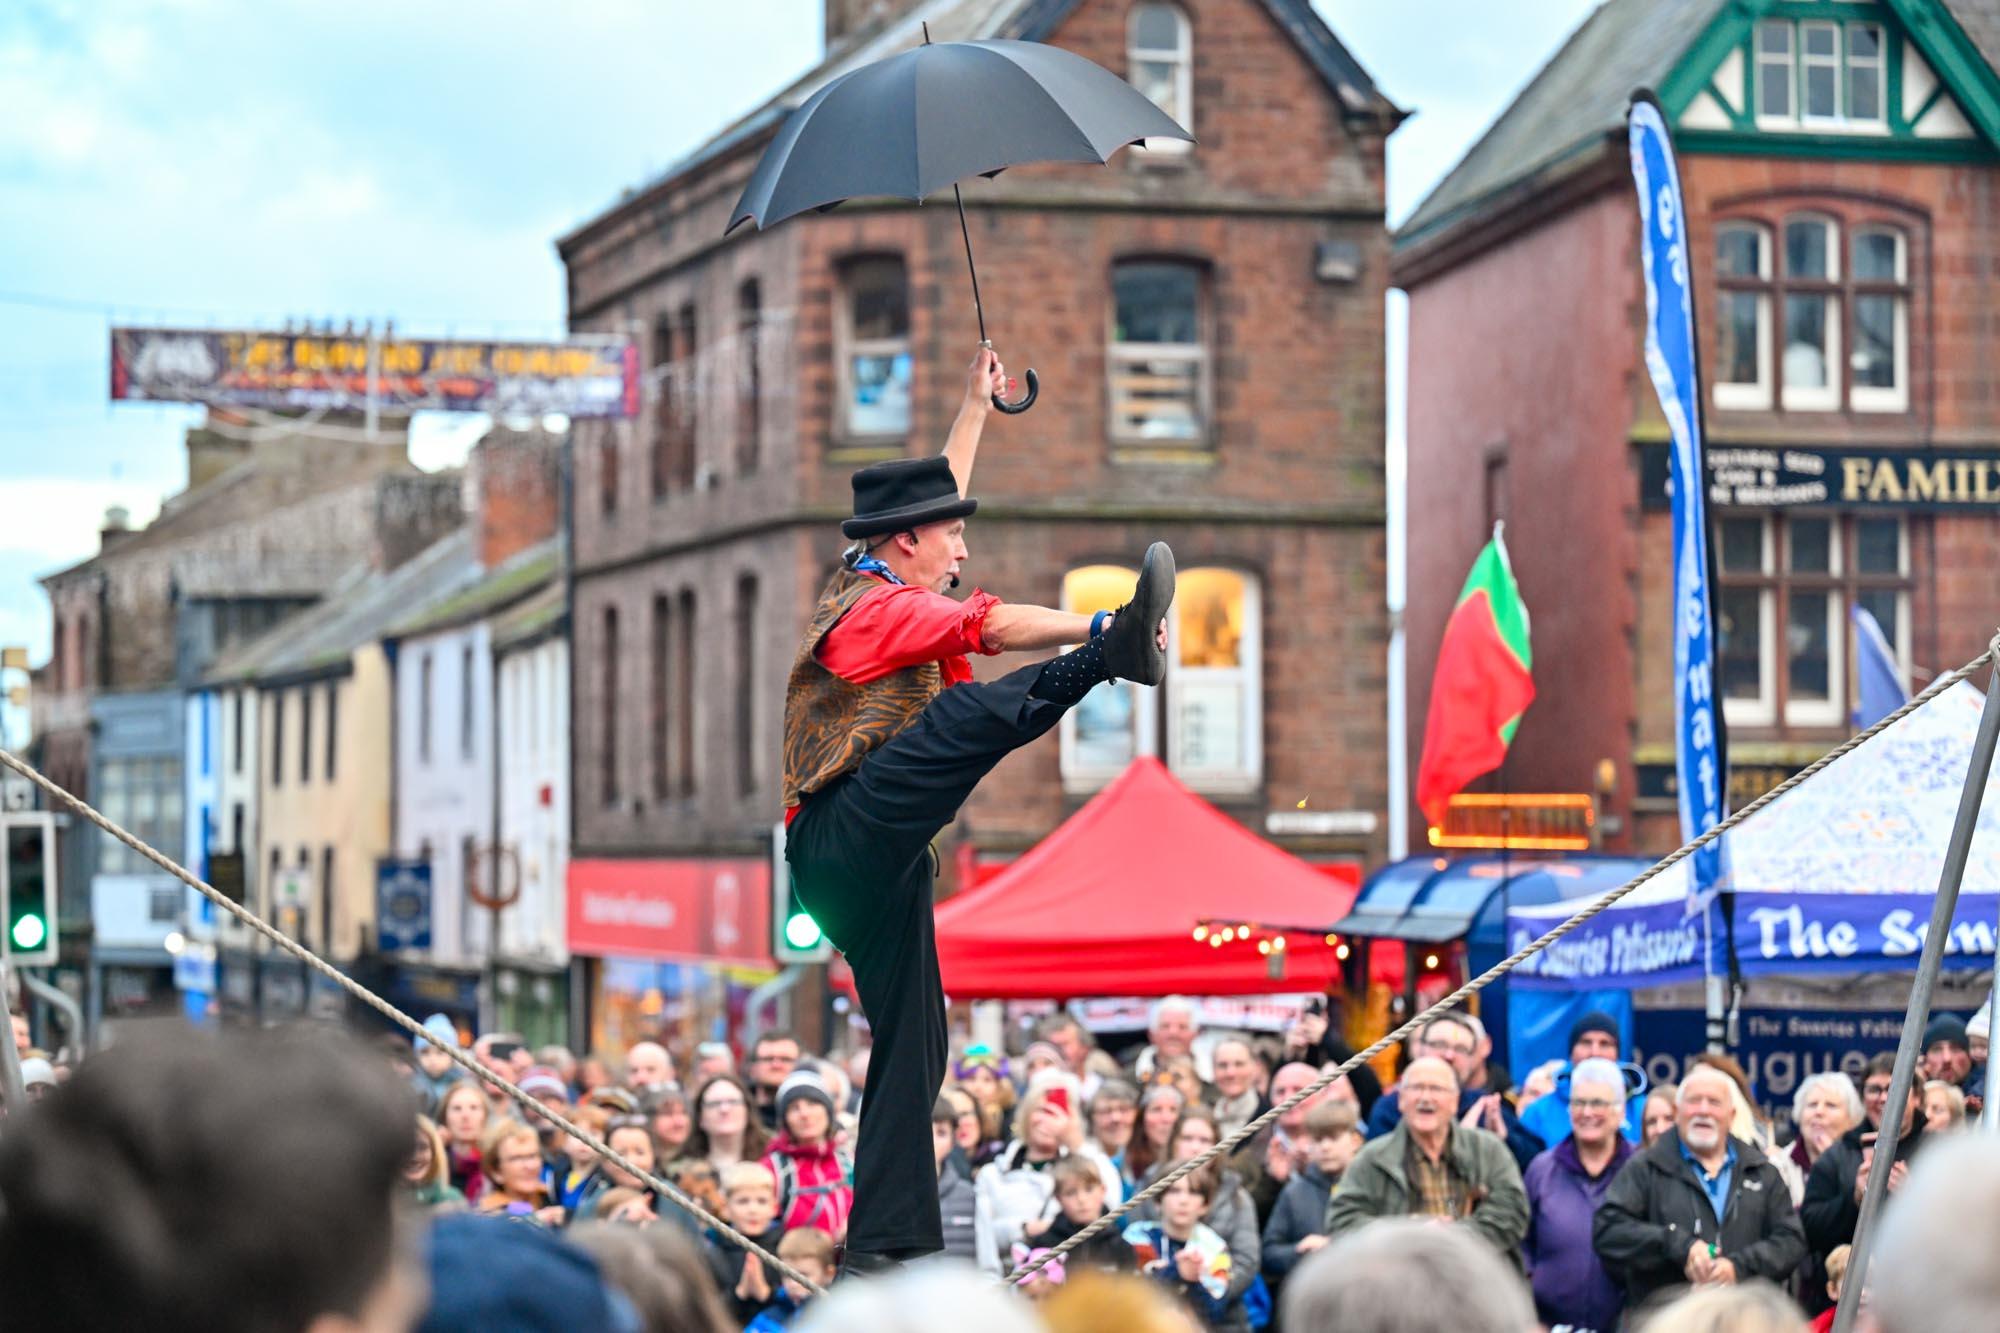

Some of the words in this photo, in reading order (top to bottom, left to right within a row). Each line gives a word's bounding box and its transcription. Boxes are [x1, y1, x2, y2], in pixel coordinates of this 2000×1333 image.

[1841, 457, 2000, 503] FAMIL
[1748, 903, 1859, 959] The
[1880, 908, 1996, 956] Sn
